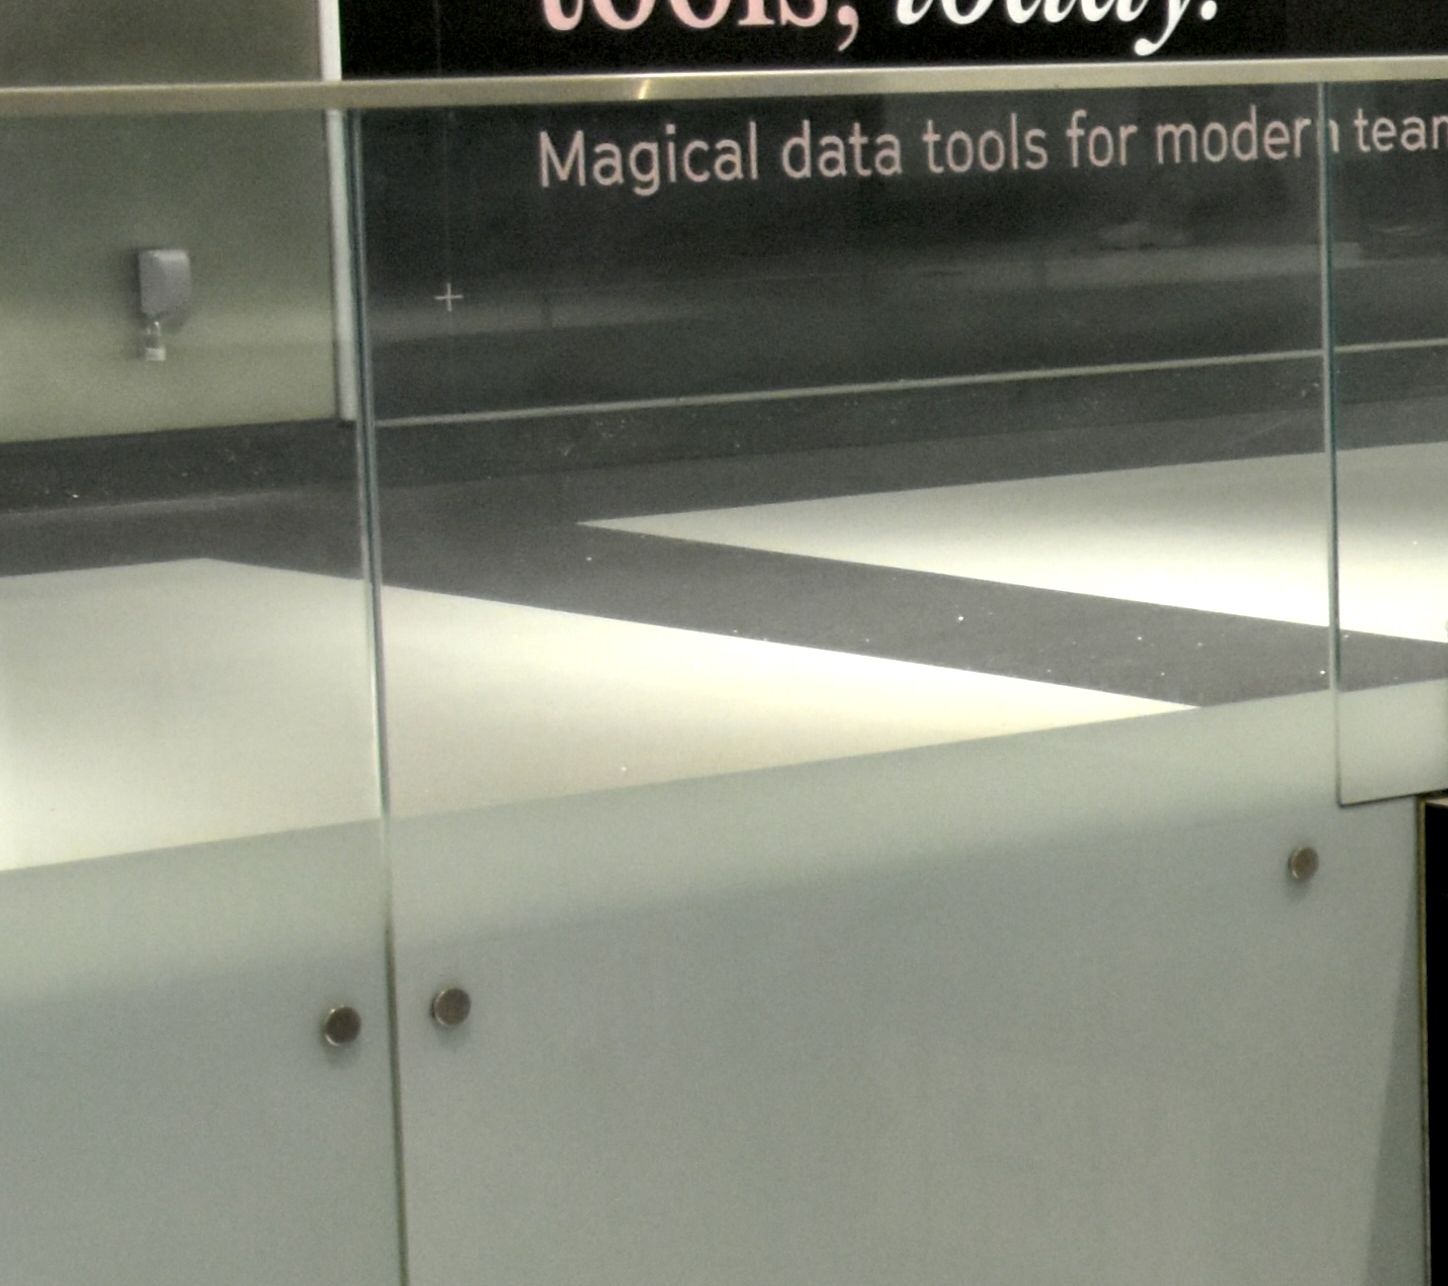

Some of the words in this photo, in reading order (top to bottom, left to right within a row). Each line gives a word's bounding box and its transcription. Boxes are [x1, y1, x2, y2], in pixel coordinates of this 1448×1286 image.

[538, 122, 759, 196] Magical
[781, 119, 903, 178] data
[922, 115, 1049, 172] tools
[1066, 109, 1135, 166] for
